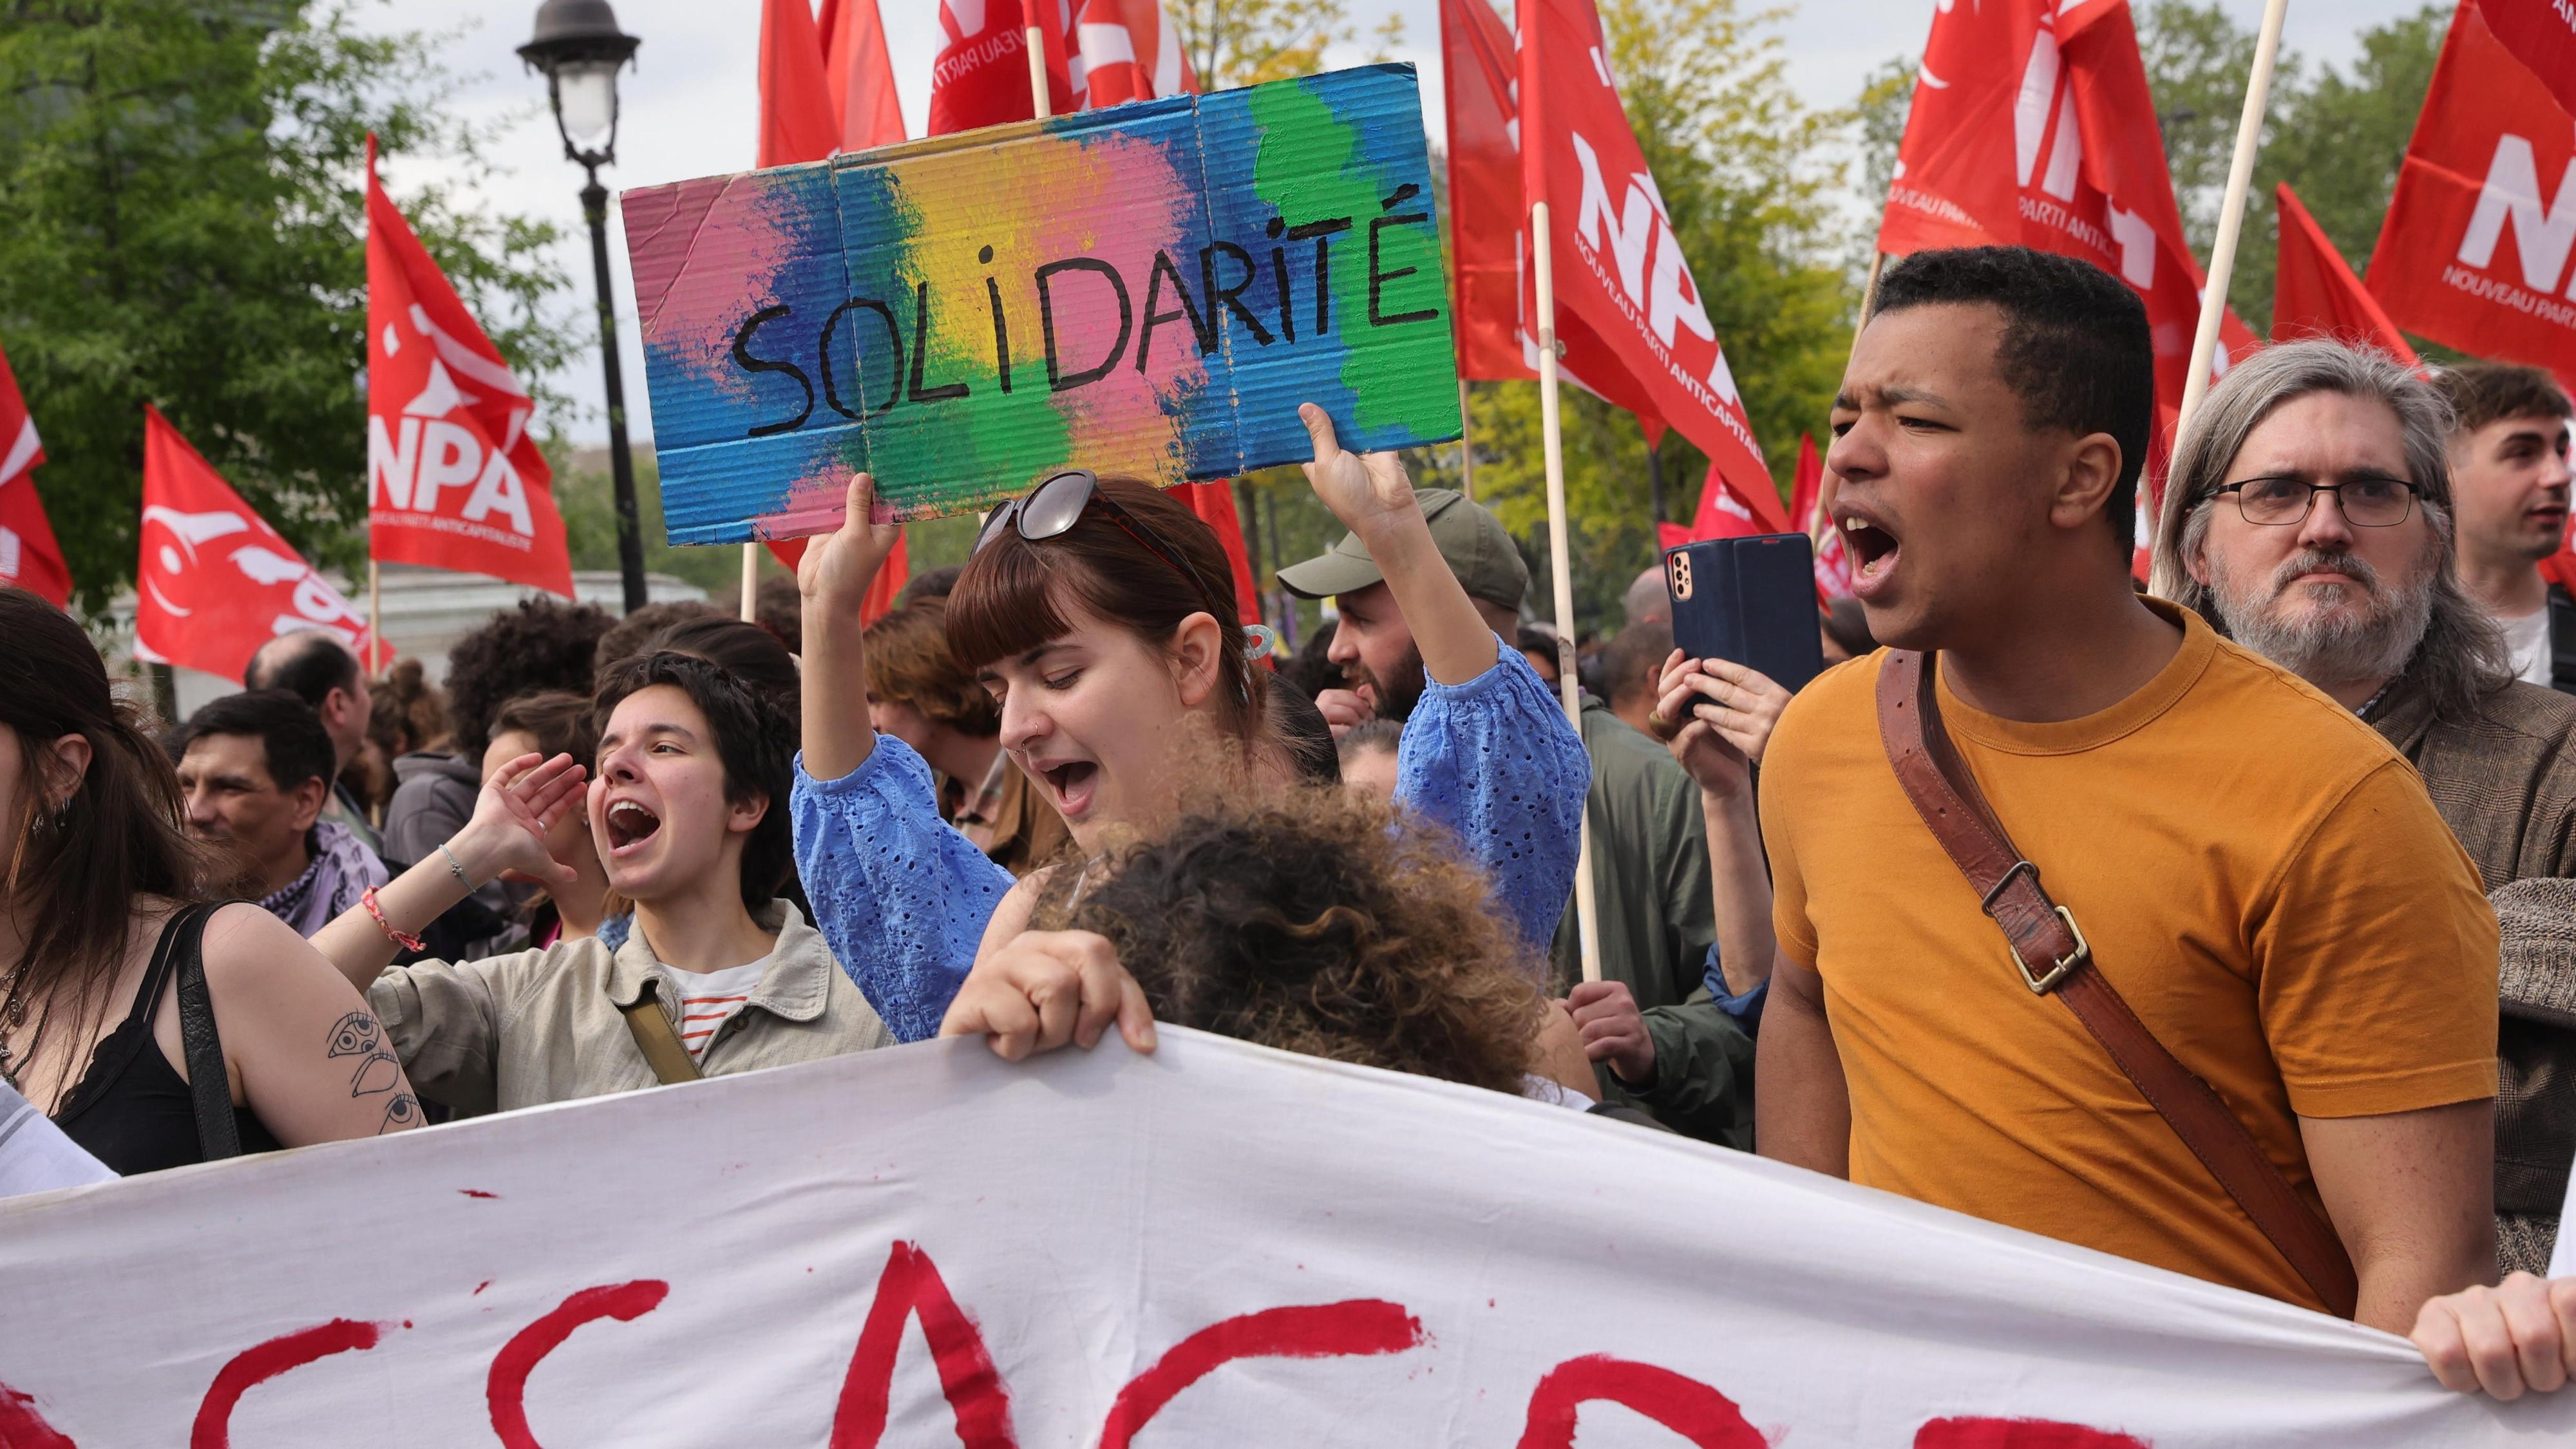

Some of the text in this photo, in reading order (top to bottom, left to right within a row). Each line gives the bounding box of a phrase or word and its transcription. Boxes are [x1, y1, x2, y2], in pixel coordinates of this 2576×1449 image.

[2018, 196, 2066, 230] PARTI
[1575, 232, 1636, 321] NOUVEAU
[1636, 315, 1670, 368] PARTI
[2442, 265, 2535, 314] NOUVEAU
[368, 415, 535, 537] NPA
